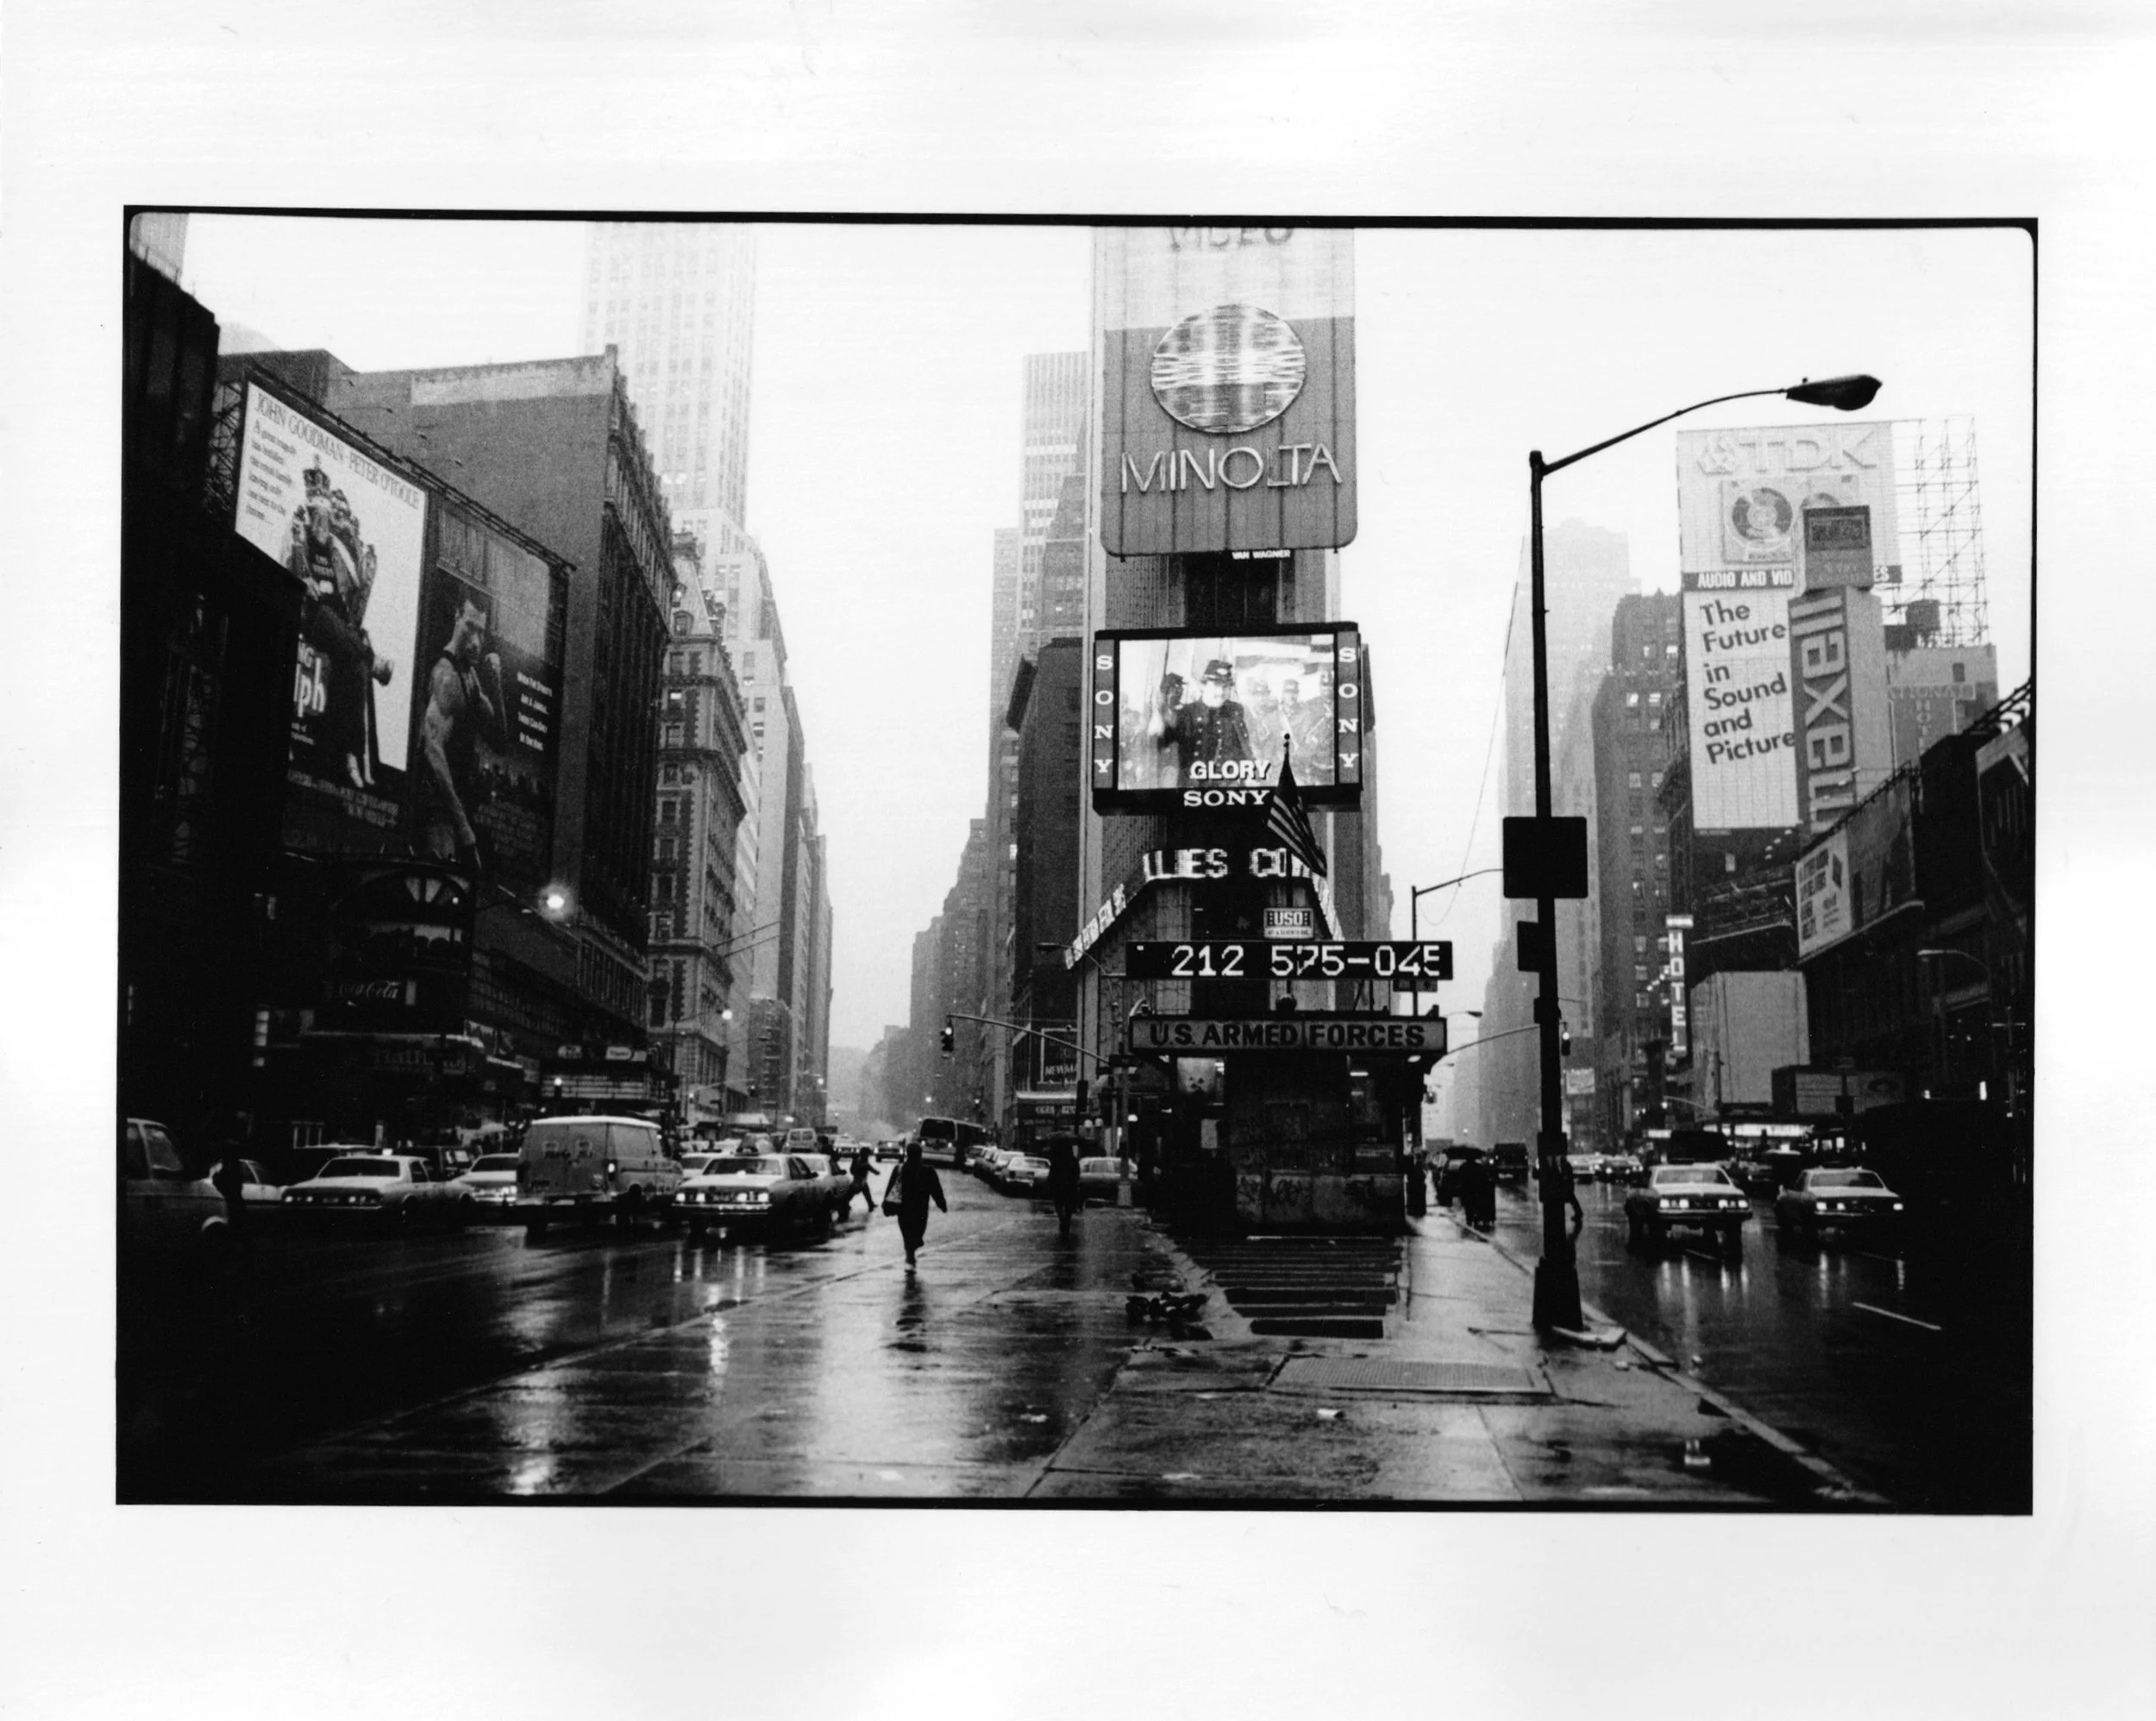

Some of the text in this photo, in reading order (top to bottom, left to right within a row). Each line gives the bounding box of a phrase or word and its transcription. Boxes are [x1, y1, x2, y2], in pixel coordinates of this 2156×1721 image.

[256, 392, 286, 426] JOHN
[288, 414, 345, 463] GOODMAN
[348, 450, 379, 485] PETER
[1737, 431, 1878, 472] TDK
[1120, 442, 1343, 493] MINOLTA
[1232, 548, 1291, 560] VAN WAGNER
[1696, 571, 1737, 589] AUDIO
[1740, 570, 1767, 587] AND
[1699, 599, 1751, 626] The
[1702, 623, 1786, 653] Future
[1703, 663, 1731, 684] in
[1702, 672, 1788, 710] Sound
[1094, 654, 1114, 773] SONY
[1338, 646, 1359, 768] SONY
[1703, 707, 1753, 737] and
[1706, 732, 1796, 766] Picture
[1190, 760, 1271, 780] GLORY
[1183, 789, 1270, 807] SONY
[1274, 911, 1304, 926] USO
[1171, 944, 1244, 976] 212
[1668, 931, 1688, 1052] HOTEL
[1149, 1023, 1426, 1047] U.S. ARMED FORCES
